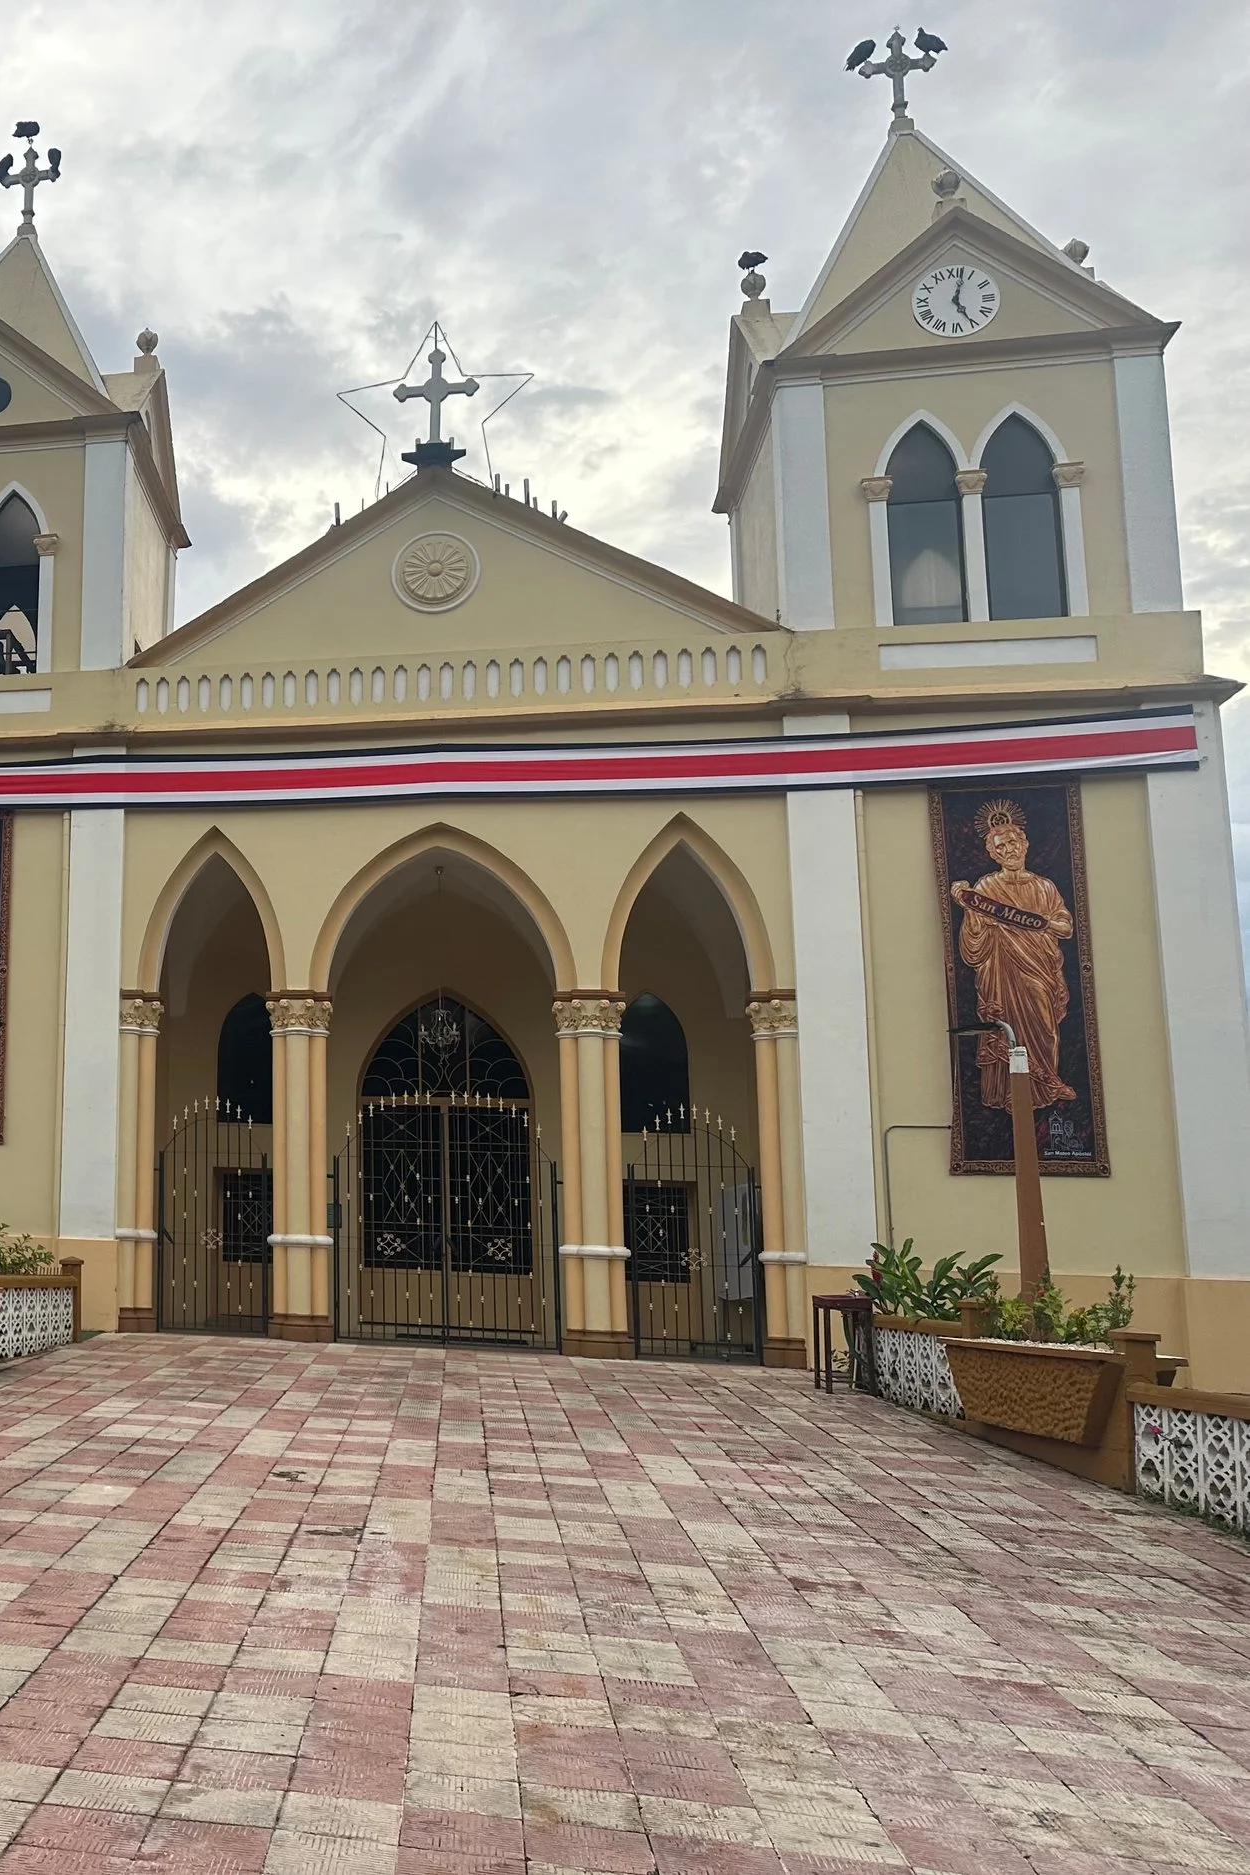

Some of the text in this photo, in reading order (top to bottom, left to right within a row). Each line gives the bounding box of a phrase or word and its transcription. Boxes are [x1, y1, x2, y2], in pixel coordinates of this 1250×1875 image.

[931, 271, 945, 284] XI
[946, 267, 963, 279] XII
[967, 270, 975, 280] I
[919, 283, 934, 294] X
[977, 279, 990, 289] II
[916, 297, 929, 308] IX
[982, 293, 995, 303] III
[919, 308, 935, 325] VIII
[979, 306, 993, 318] IV
[932, 318, 947, 332] VII
[952, 322, 964, 333] VI
[969, 318, 980, 329] V
[970, 895, 1042, 927] San Mateo
